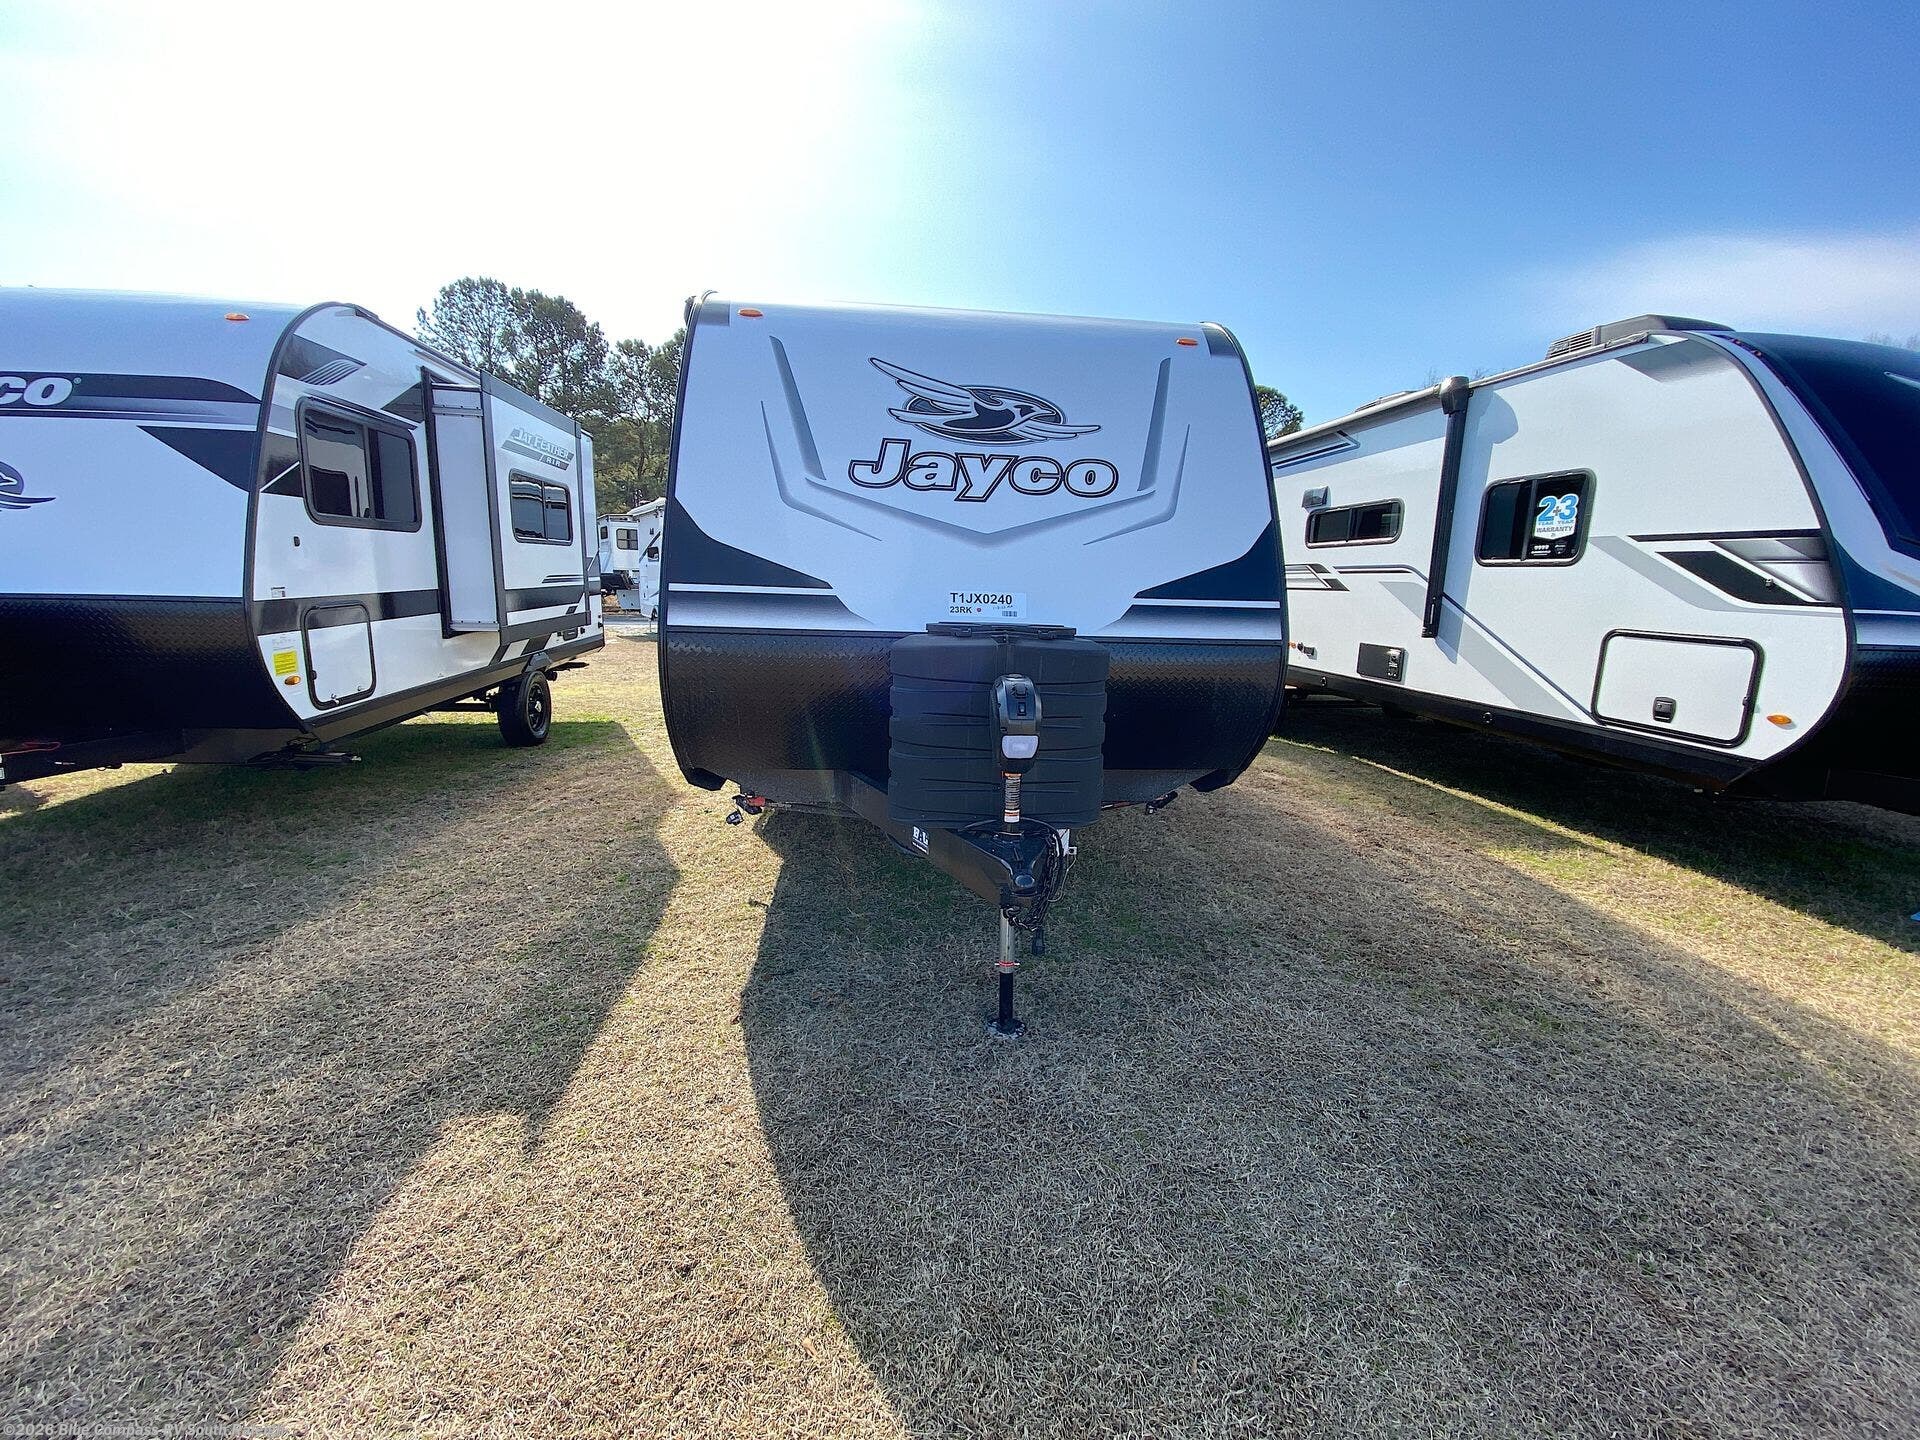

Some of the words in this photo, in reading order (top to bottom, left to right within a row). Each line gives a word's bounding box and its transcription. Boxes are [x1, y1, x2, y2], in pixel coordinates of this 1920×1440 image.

[848, 437, 1119, 502] Jayco
[950, 592, 1013, 605] T1JX0240
[949, 606, 972, 614] 23RK
